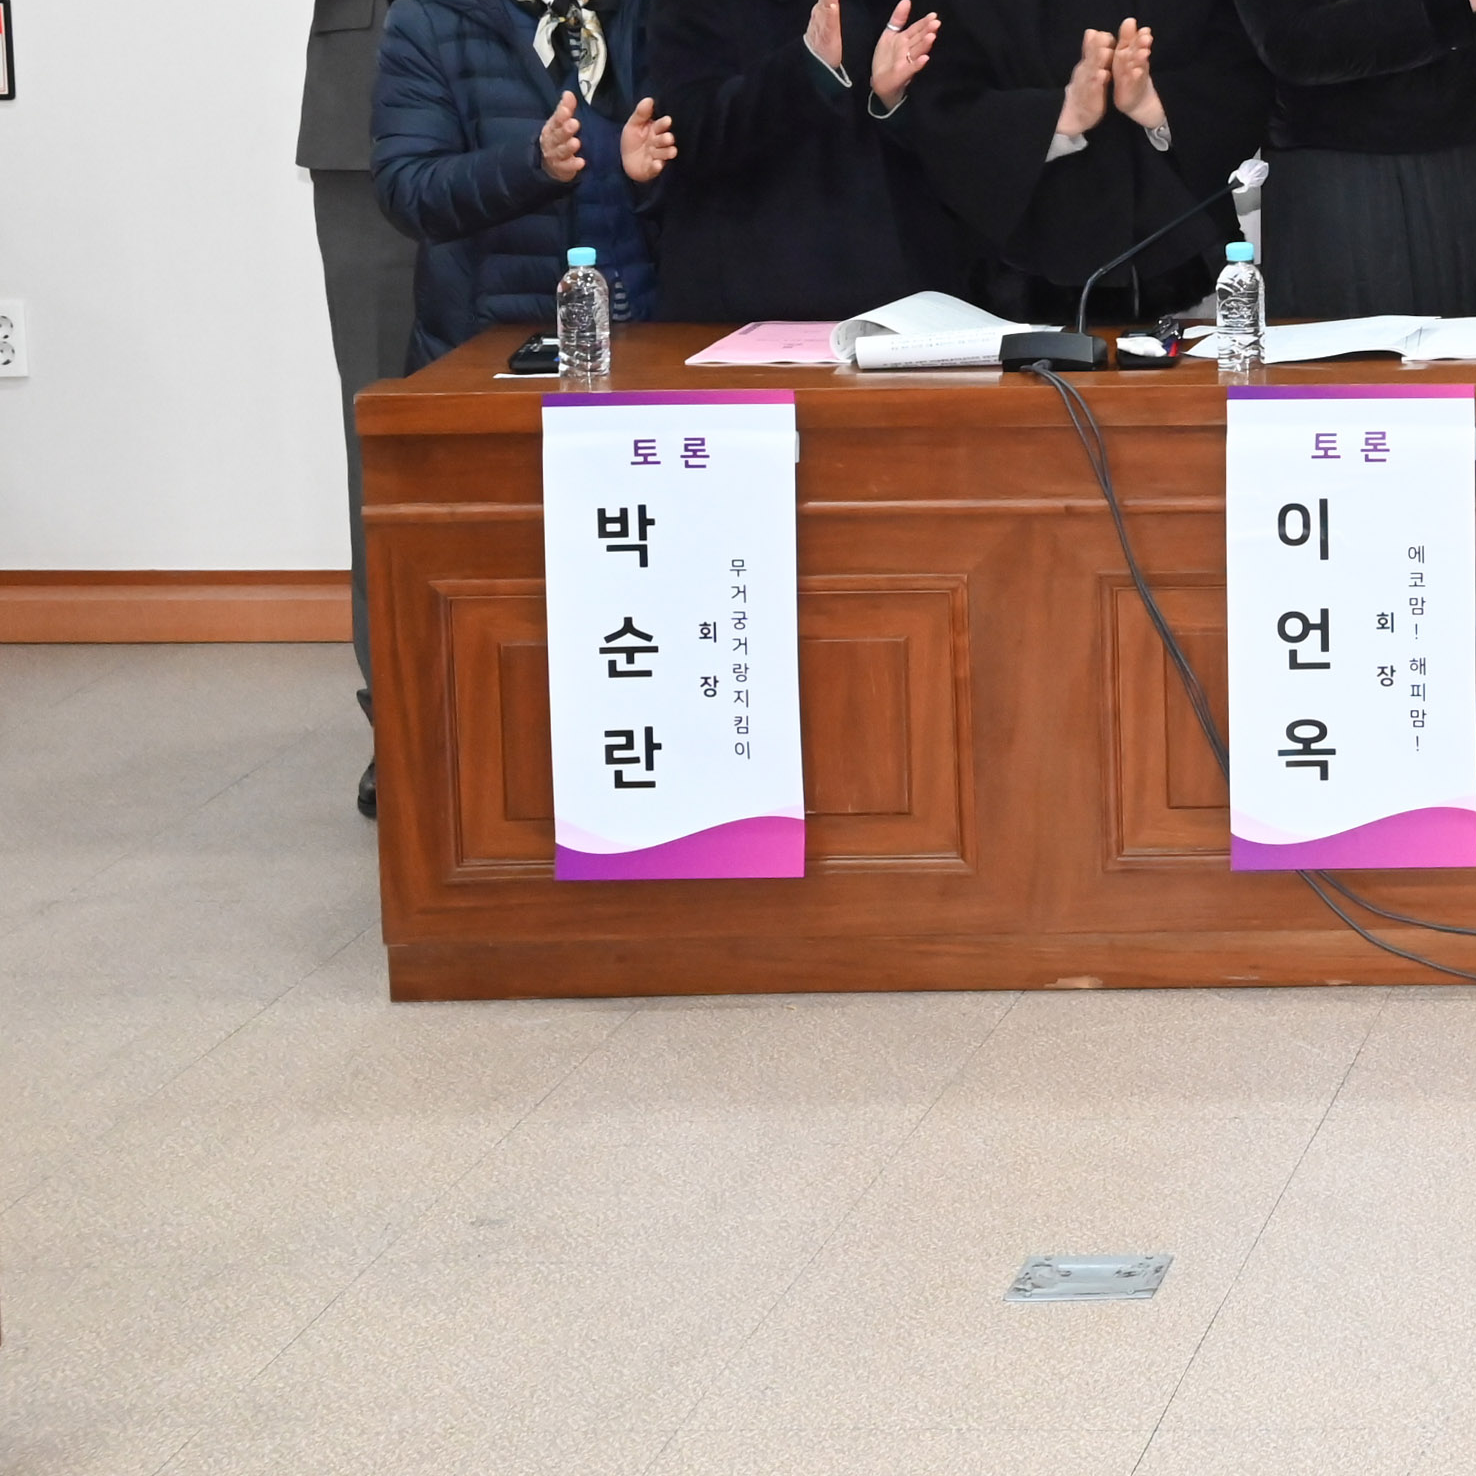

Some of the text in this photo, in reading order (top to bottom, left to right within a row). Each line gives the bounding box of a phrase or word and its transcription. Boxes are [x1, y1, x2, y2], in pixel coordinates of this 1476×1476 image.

[630, 437, 711, 469] 토론
[1310, 431, 1391, 463] 토론
[596, 503, 663, 790] 박순란
[698, 621, 720, 698] 회장
[729, 558, 751, 760] 무거궁거랑지킴이
[1276, 497, 1337, 782] 이언옥
[1376, 611, 1397, 688] 회장
[1407, 545, 1427, 752] 에코맘! 해피맘!
